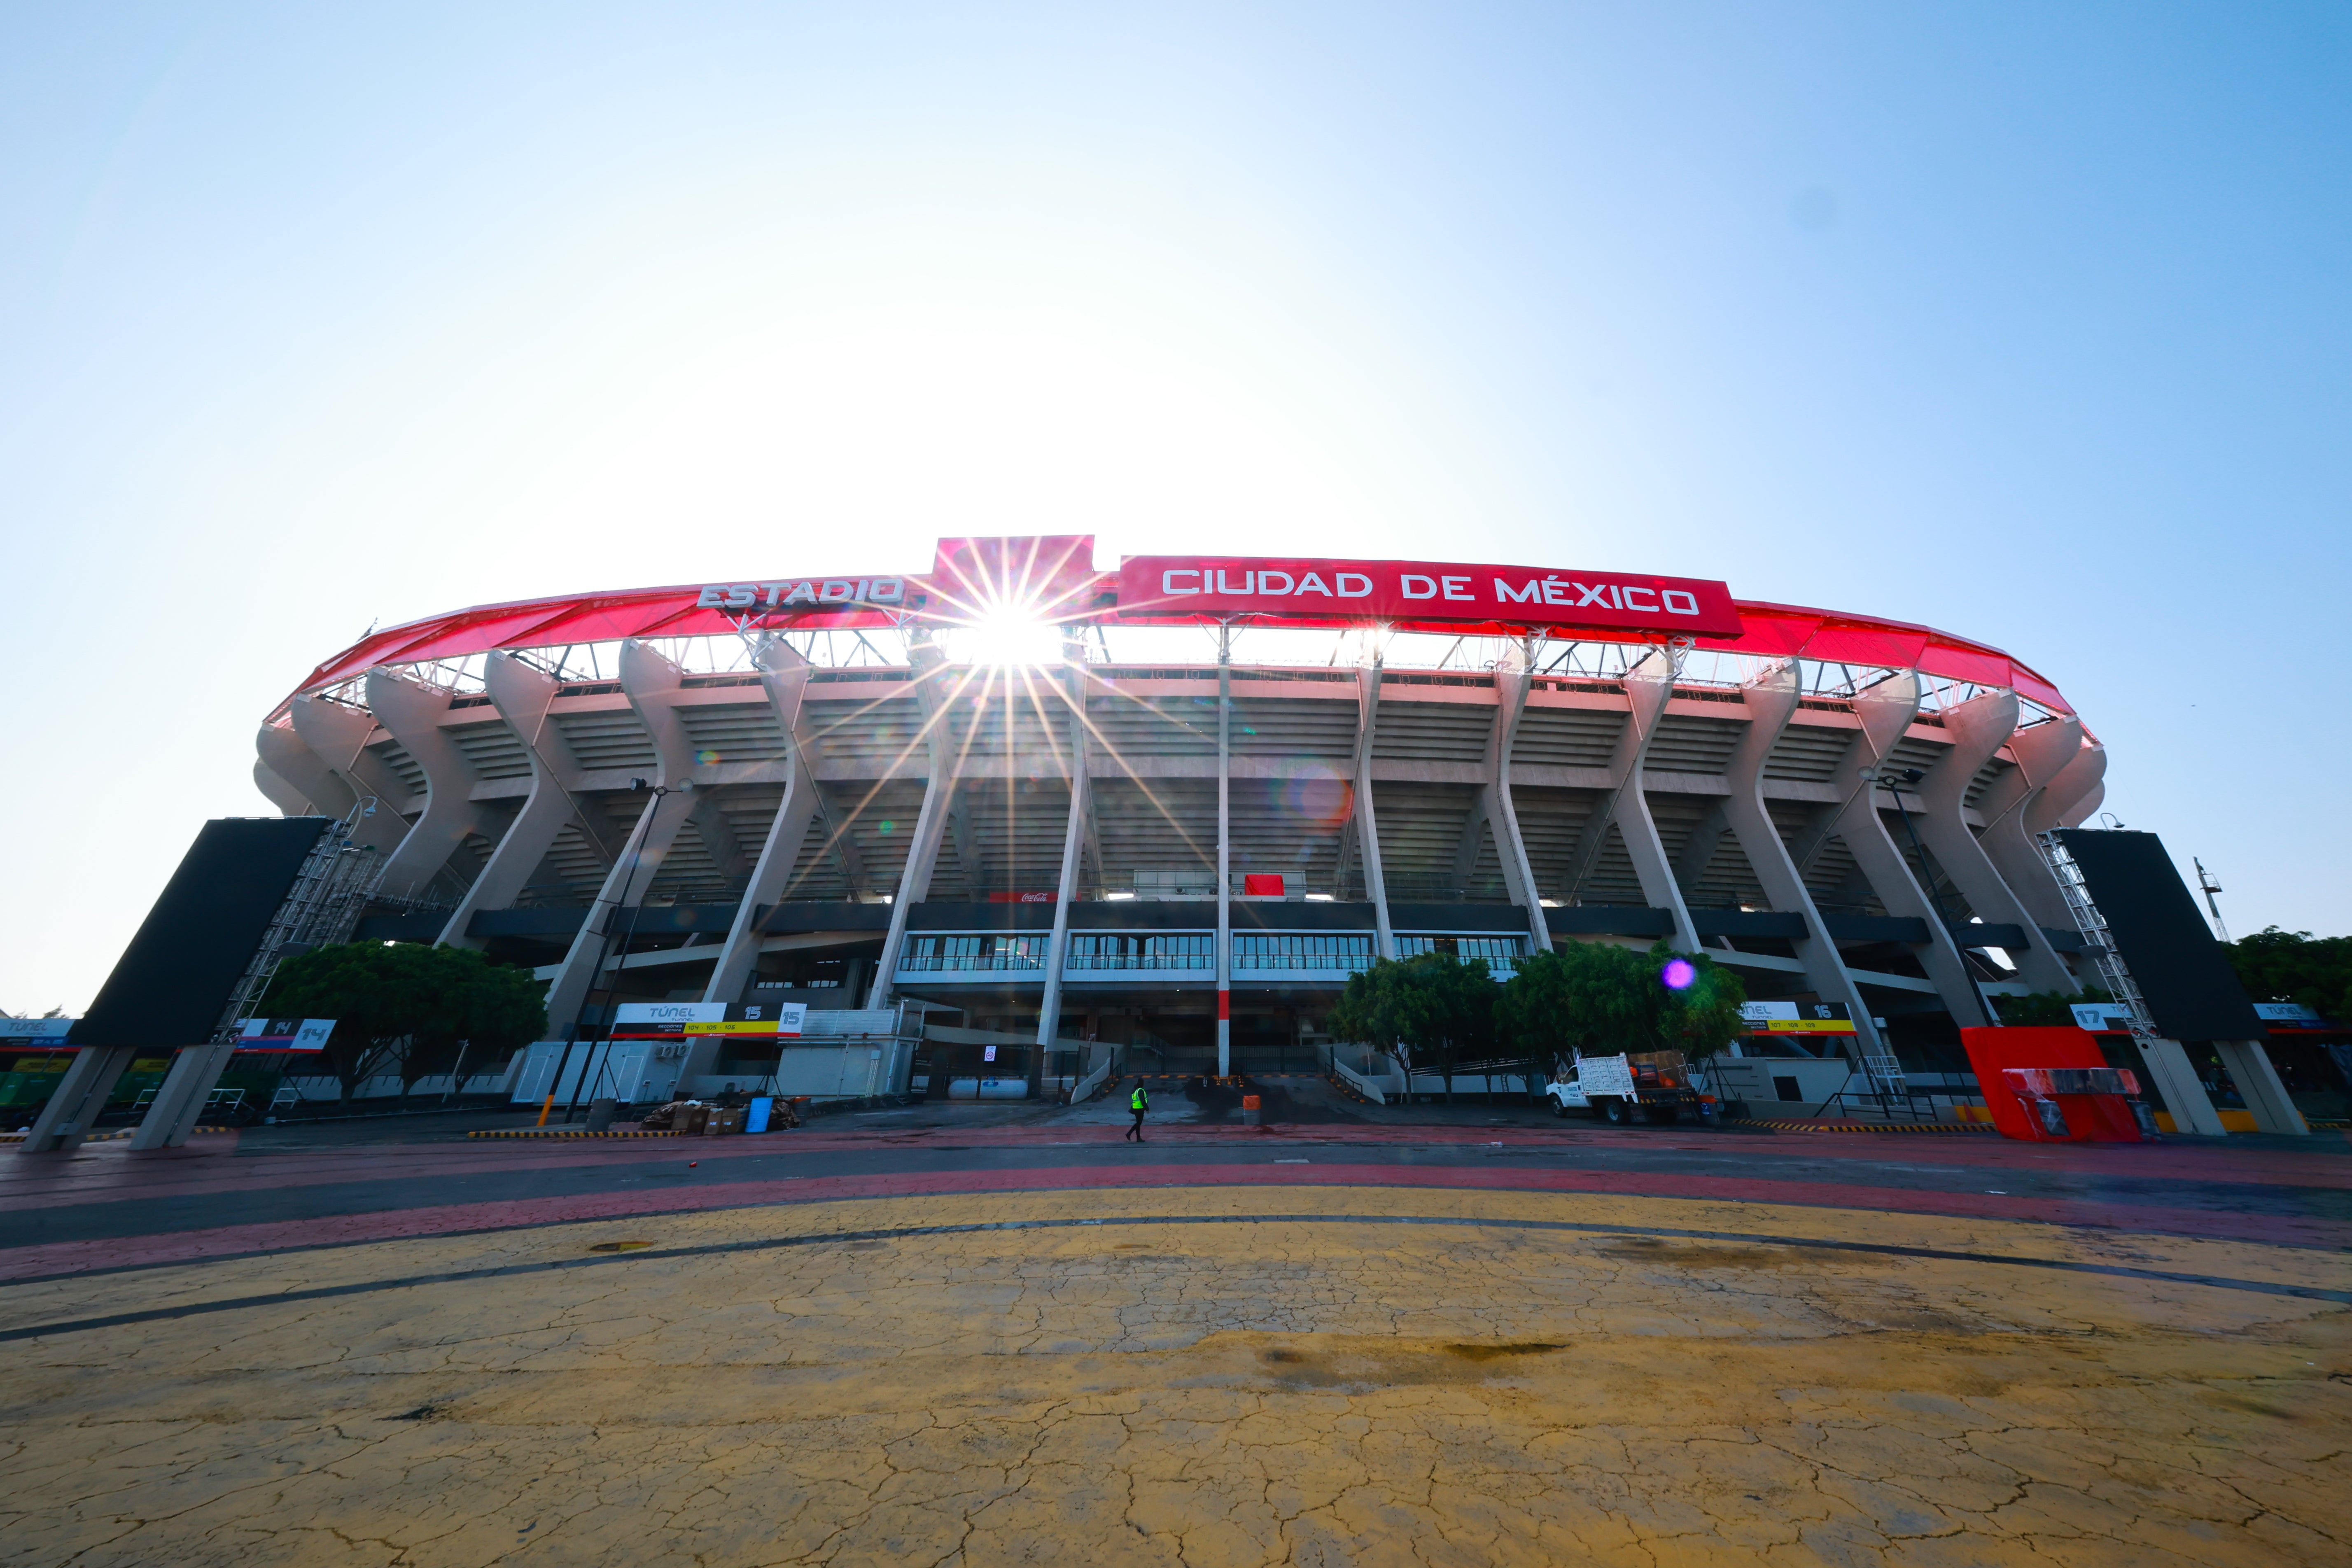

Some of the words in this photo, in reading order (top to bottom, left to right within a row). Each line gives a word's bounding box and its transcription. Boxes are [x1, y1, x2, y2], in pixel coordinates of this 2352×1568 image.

[696, 579, 905, 609] ESTADIO
[1162, 569, 1373, 597] CIUDAD
[1400, 574, 1475, 601] DE
[1494, 575, 1699, 615] MÉXICO
[650, 1006, 695, 1017] TÚNEL
[744, 1006, 762, 1020] 15
[783, 1011, 800, 1025] 15
[1814, 1005, 1832, 1018] 16
[2076, 1010, 2100, 1024] 17
[274, 1022, 292, 1034] 14
[302, 1028, 327, 1041] 14
